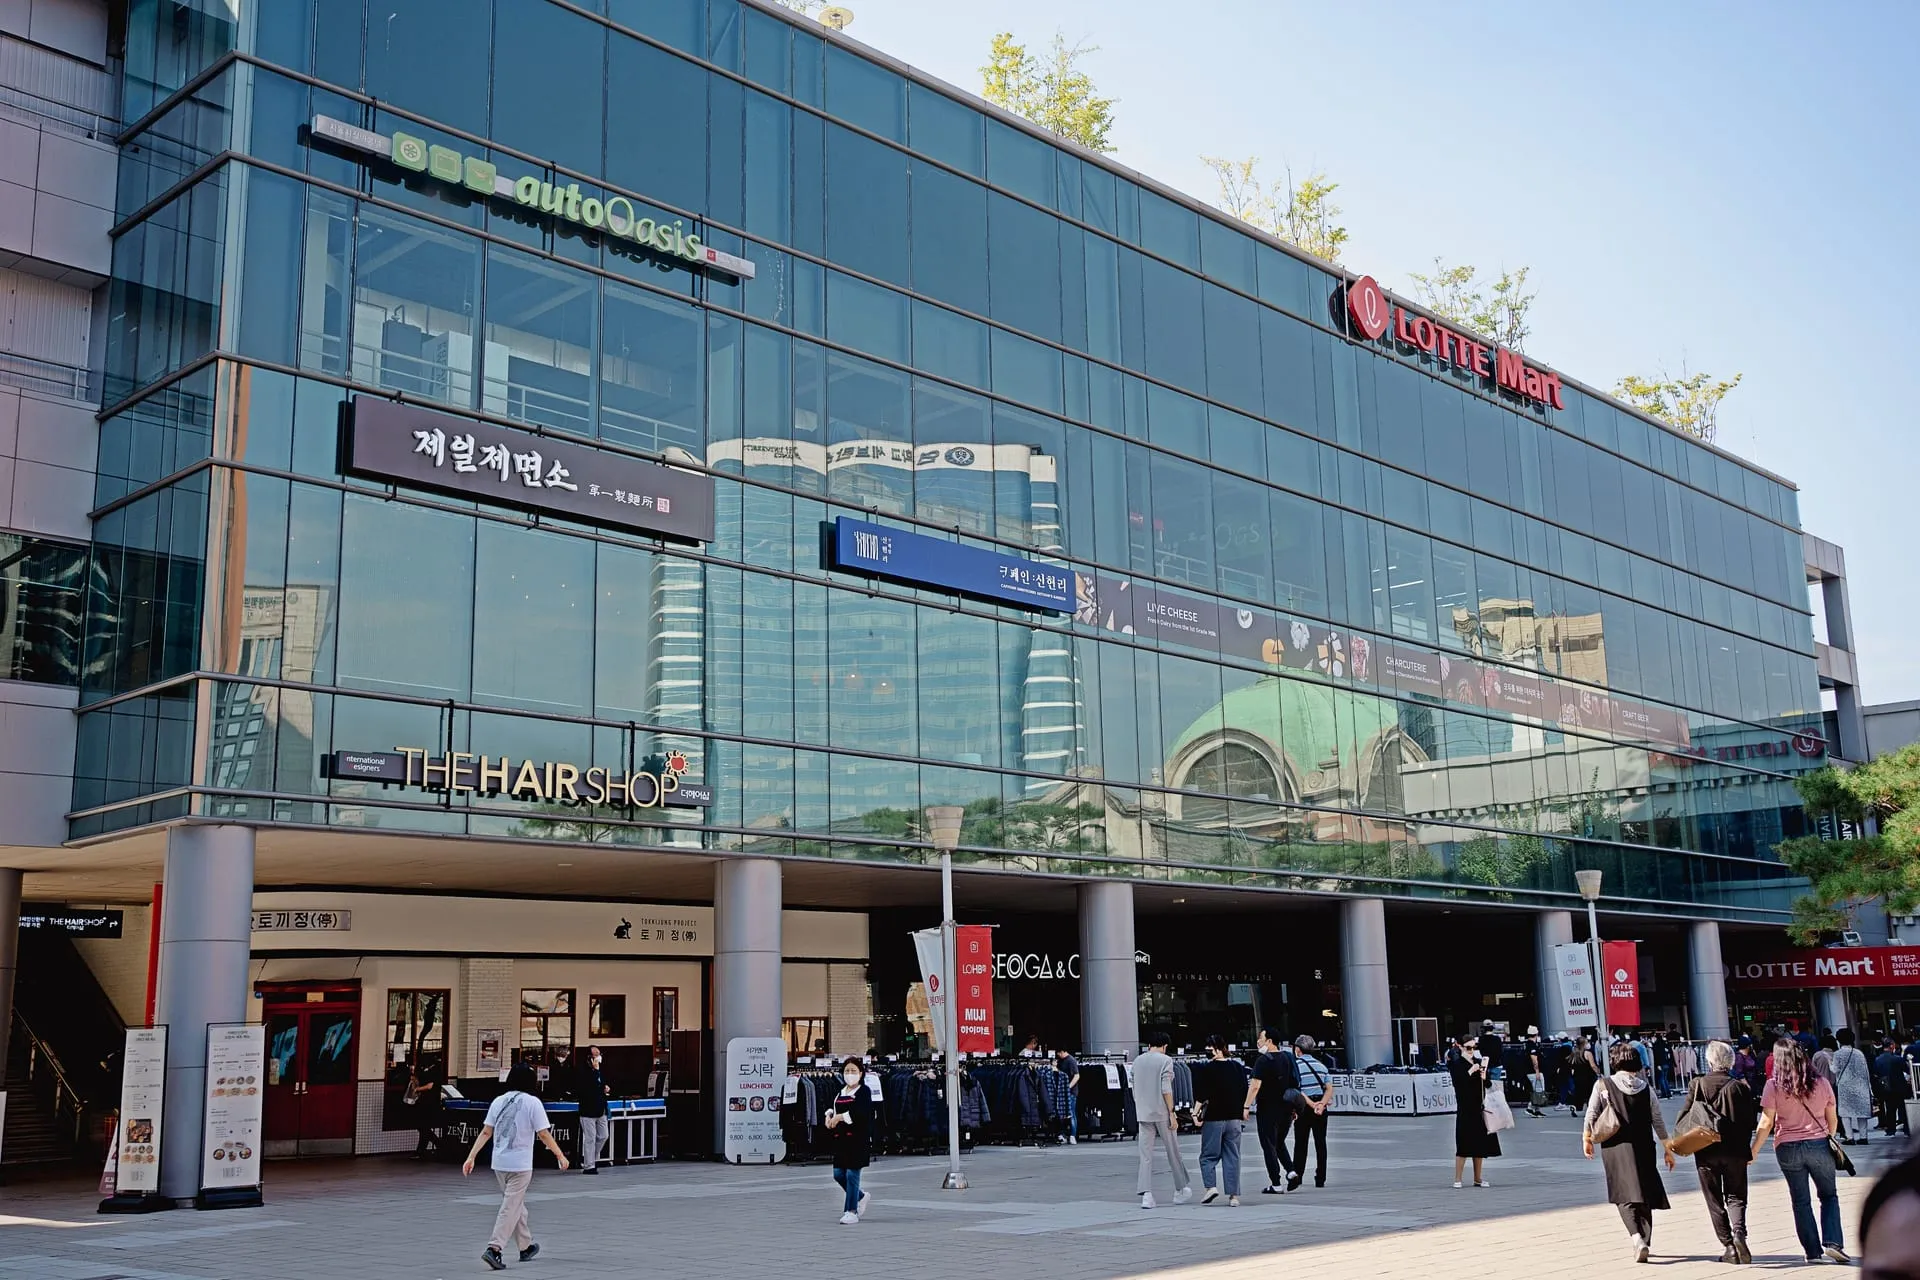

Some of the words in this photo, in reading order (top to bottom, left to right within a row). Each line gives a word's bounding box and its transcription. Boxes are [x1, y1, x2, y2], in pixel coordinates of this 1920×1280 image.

[1394, 307, 1490, 378] LOTTE
[1497, 348, 1565, 411] Mart
[413, 428, 579, 492] 제일제면소
[1147, 602, 1166, 615] LIVE
[1167, 607, 1198, 623] CHEESE
[1385, 656, 1427, 673] CHARCUTERIE
[394, 747, 474, 791] THE
[480, 755, 580, 800] HAIR
[586, 766, 680, 809] SHOP
[49, 917, 64, 925] THE
[1735, 962, 1806, 979] LOTTE
[1815, 957, 1875, 976] Mart
[1611, 990, 1634, 998] Mart
[1570, 997, 1589, 1007] MUJI
[965, 1008, 986, 1022] MUJI
[960, 1025, 990, 1035] 하이마트
[739, 1063, 775, 1077] 도시락
[1373, 1094, 1407, 1109] 인디안
